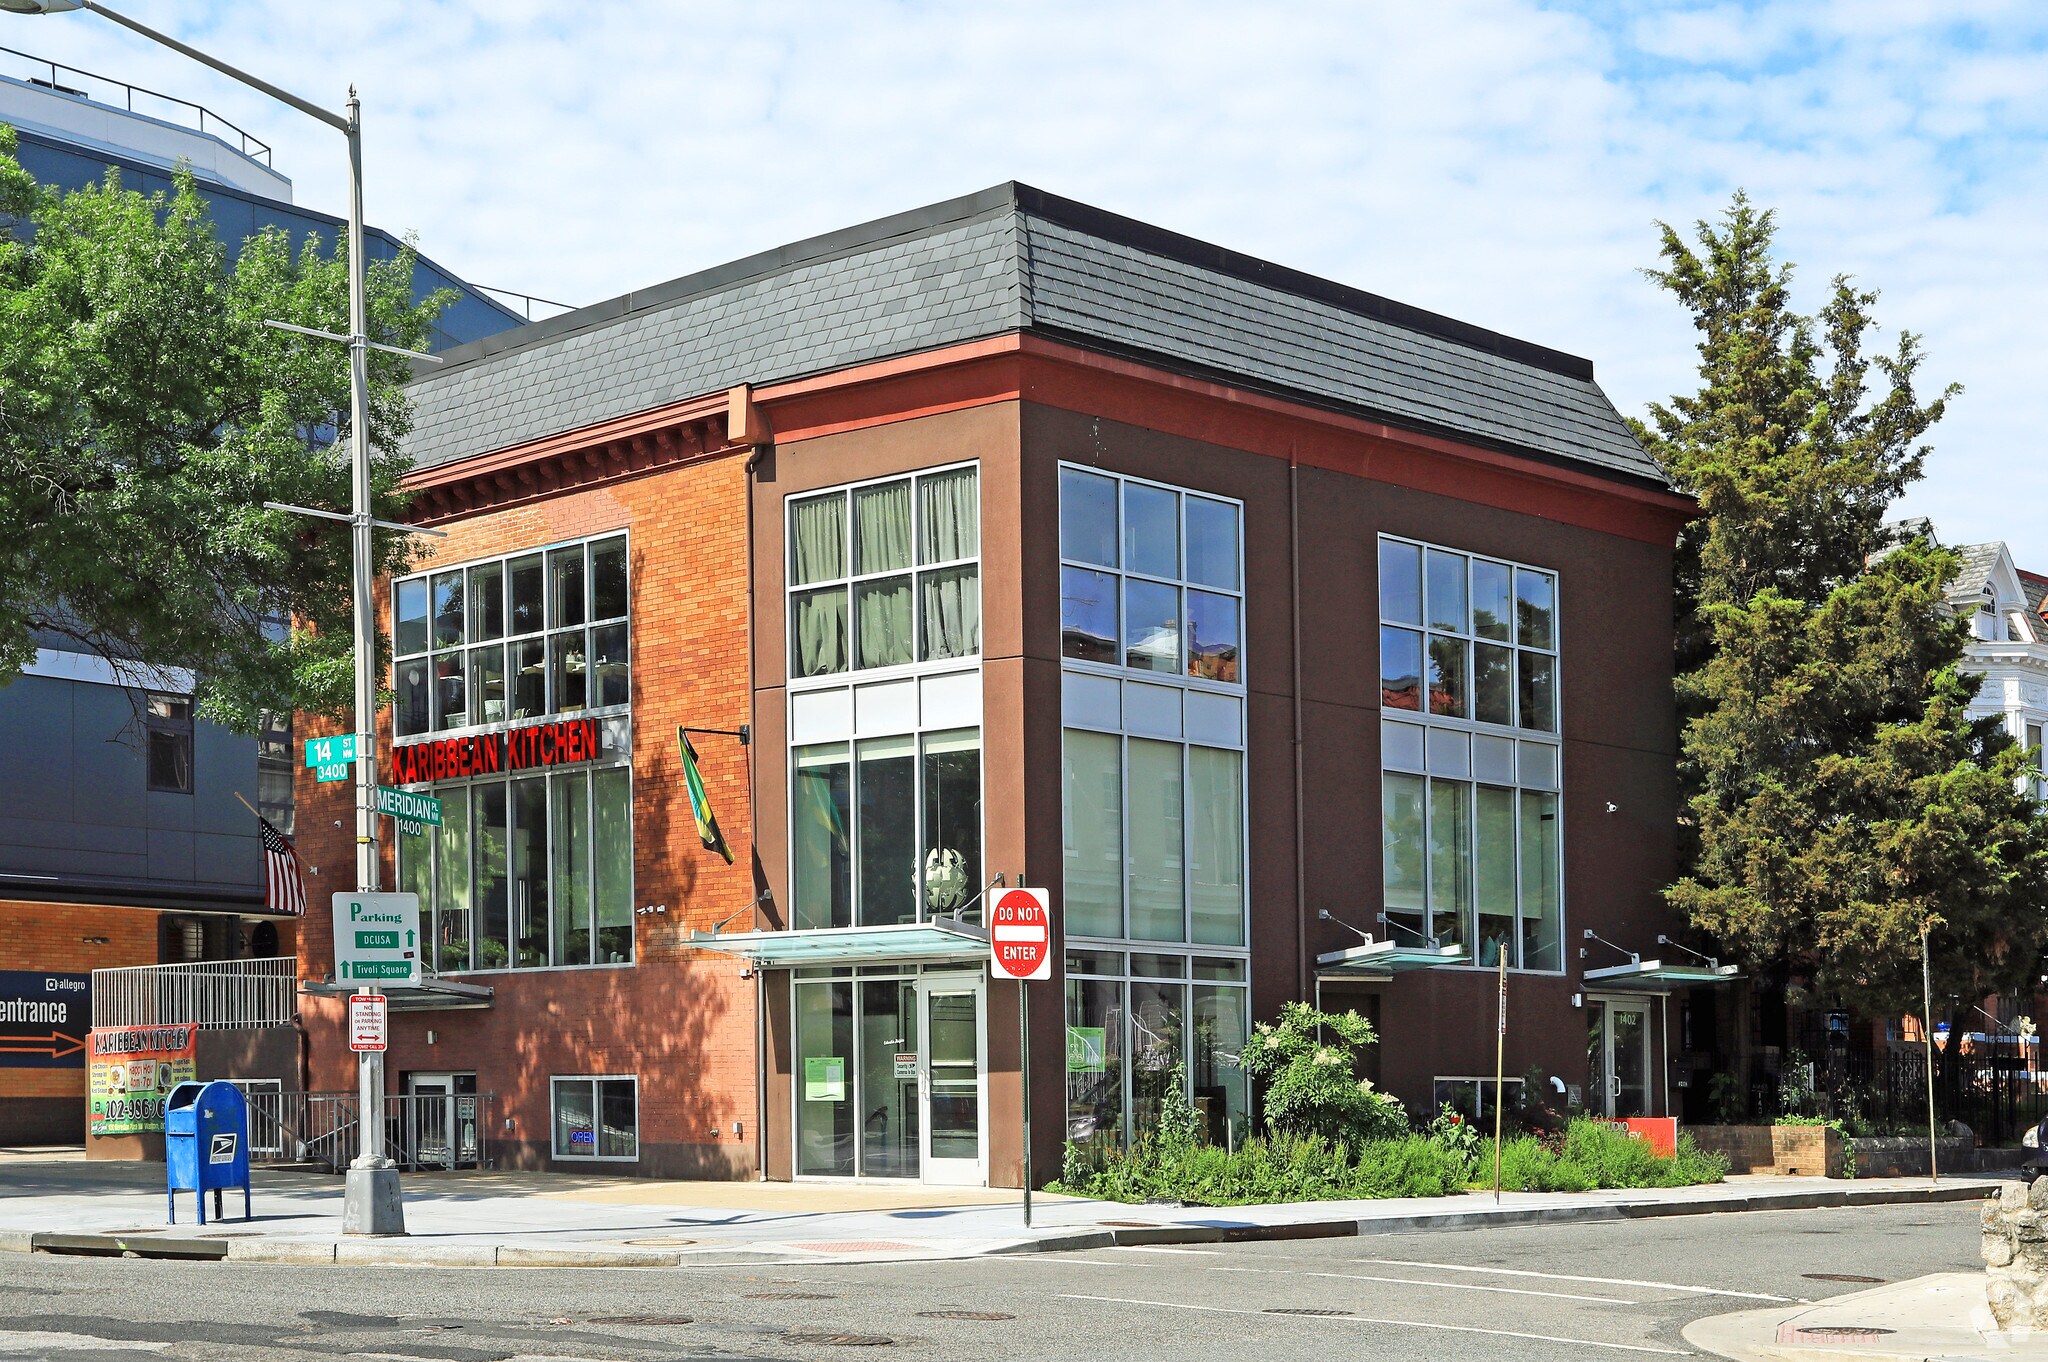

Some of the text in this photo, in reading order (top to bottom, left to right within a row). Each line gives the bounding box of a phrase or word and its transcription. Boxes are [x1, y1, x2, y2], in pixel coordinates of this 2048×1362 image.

[314, 738, 352, 762] 14 ST
[342, 749, 353, 759] NW
[393, 718, 596, 785] KARIBBEAN KITCHEN
[318, 763, 347, 779] 3400
[377, 789, 438, 820] MERIDIAN PL
[431, 812, 439, 822] NW
[400, 818, 421, 836] 1400
[350, 902, 402, 924] Parking
[999, 907, 1040, 921] DO NOT
[363, 935, 391, 945] DCUSA
[1003, 946, 1037, 960] ENTER
[356, 964, 408, 975] Tivoli Square
[59, 979, 86, 992] allegro
[0, 997, 67, 1024] entrance
[1619, 1014, 1637, 1026] 1402
[94, 1026, 190, 1055] KARIBBEAN KITCHEN
[571, 1131, 595, 1143] OPEN
